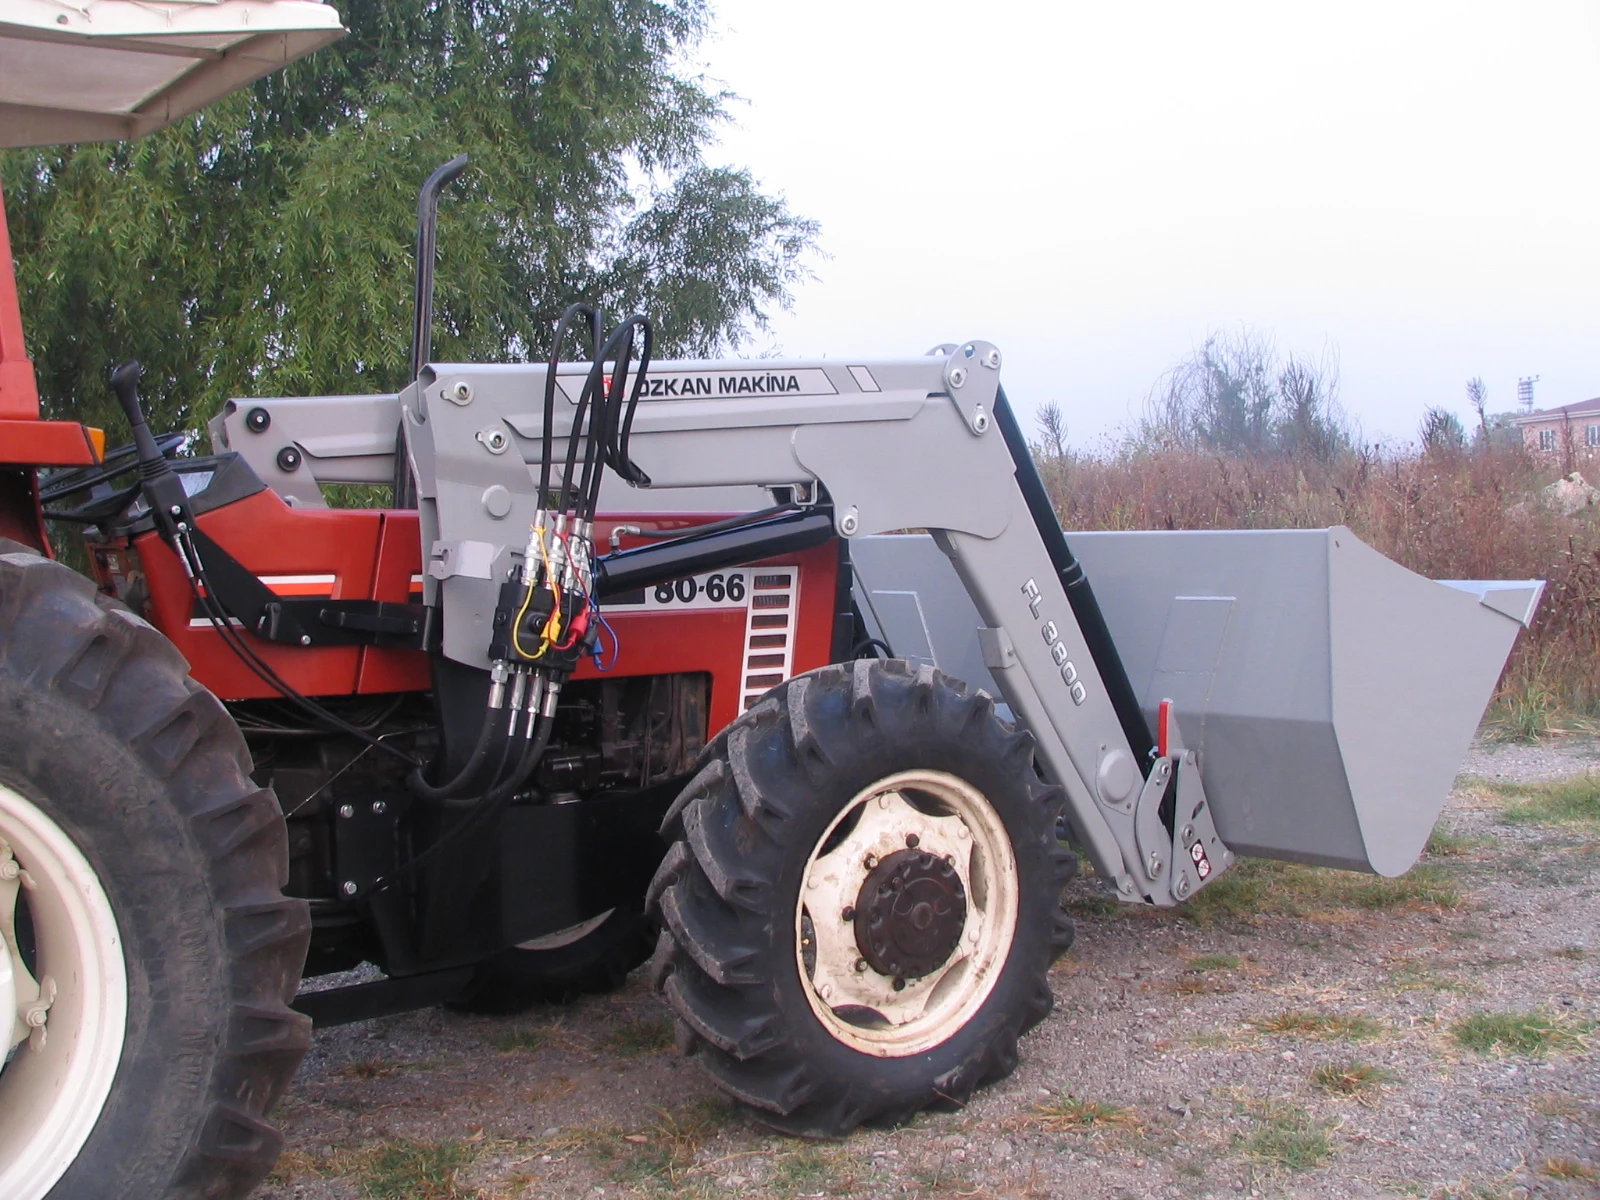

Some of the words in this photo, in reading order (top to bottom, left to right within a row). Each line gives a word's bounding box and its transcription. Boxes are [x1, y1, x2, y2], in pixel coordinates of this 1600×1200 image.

[718, 371, 800, 394] MAKİNA
[654, 573, 745, 604] 80-66
[1020, 577, 1043, 620] FL
[1041, 619, 1088, 707] 3800
